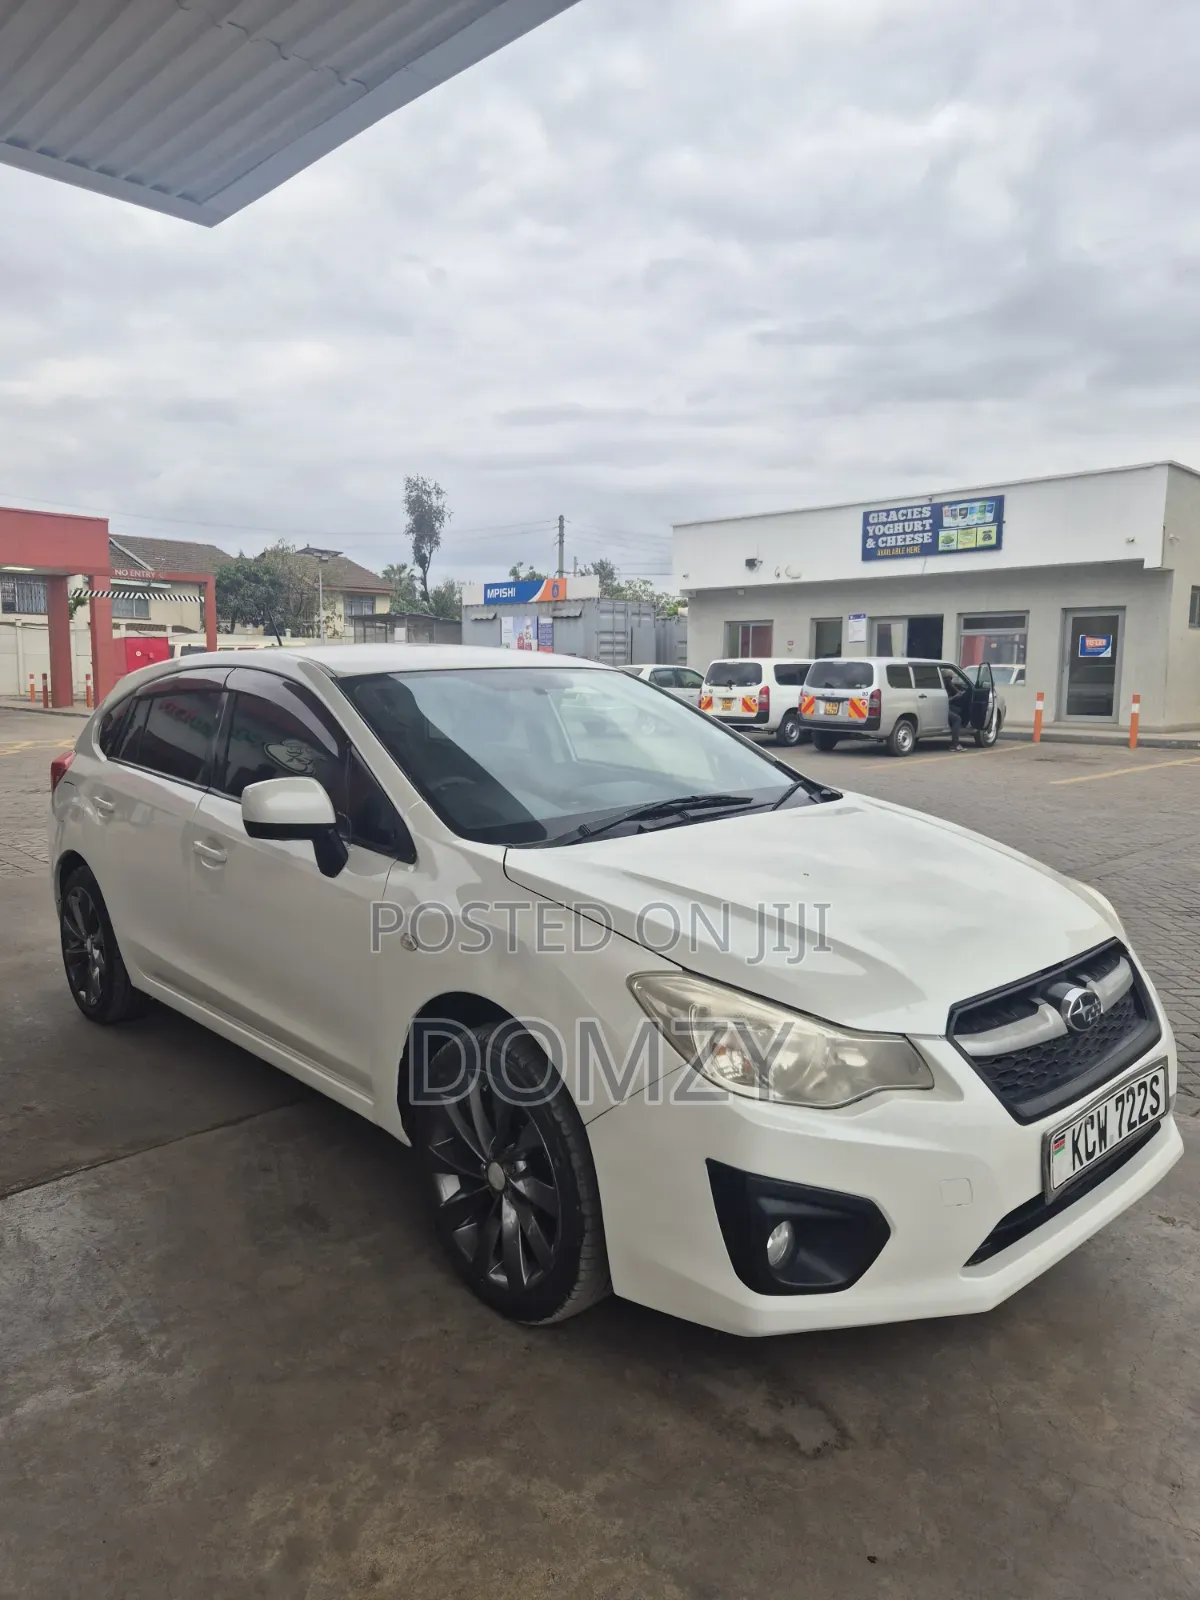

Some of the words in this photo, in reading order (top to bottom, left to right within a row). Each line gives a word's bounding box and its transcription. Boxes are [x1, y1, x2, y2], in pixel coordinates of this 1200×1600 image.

[869, 507, 931, 523] GRACIES
[867, 520, 932, 536] YOGHURT
[866, 538, 875, 548] &
[878, 533, 932, 547] CHEESE
[876, 547, 905, 557] AVAILABLE
[906, 545, 921, 555] HERE
[130, 569, 156, 578] ENTRY
[487, 587, 516, 599] MPISHI
[1071, 1105, 1108, 1172] KCW
[1116, 1075, 1160, 1138] 722S
